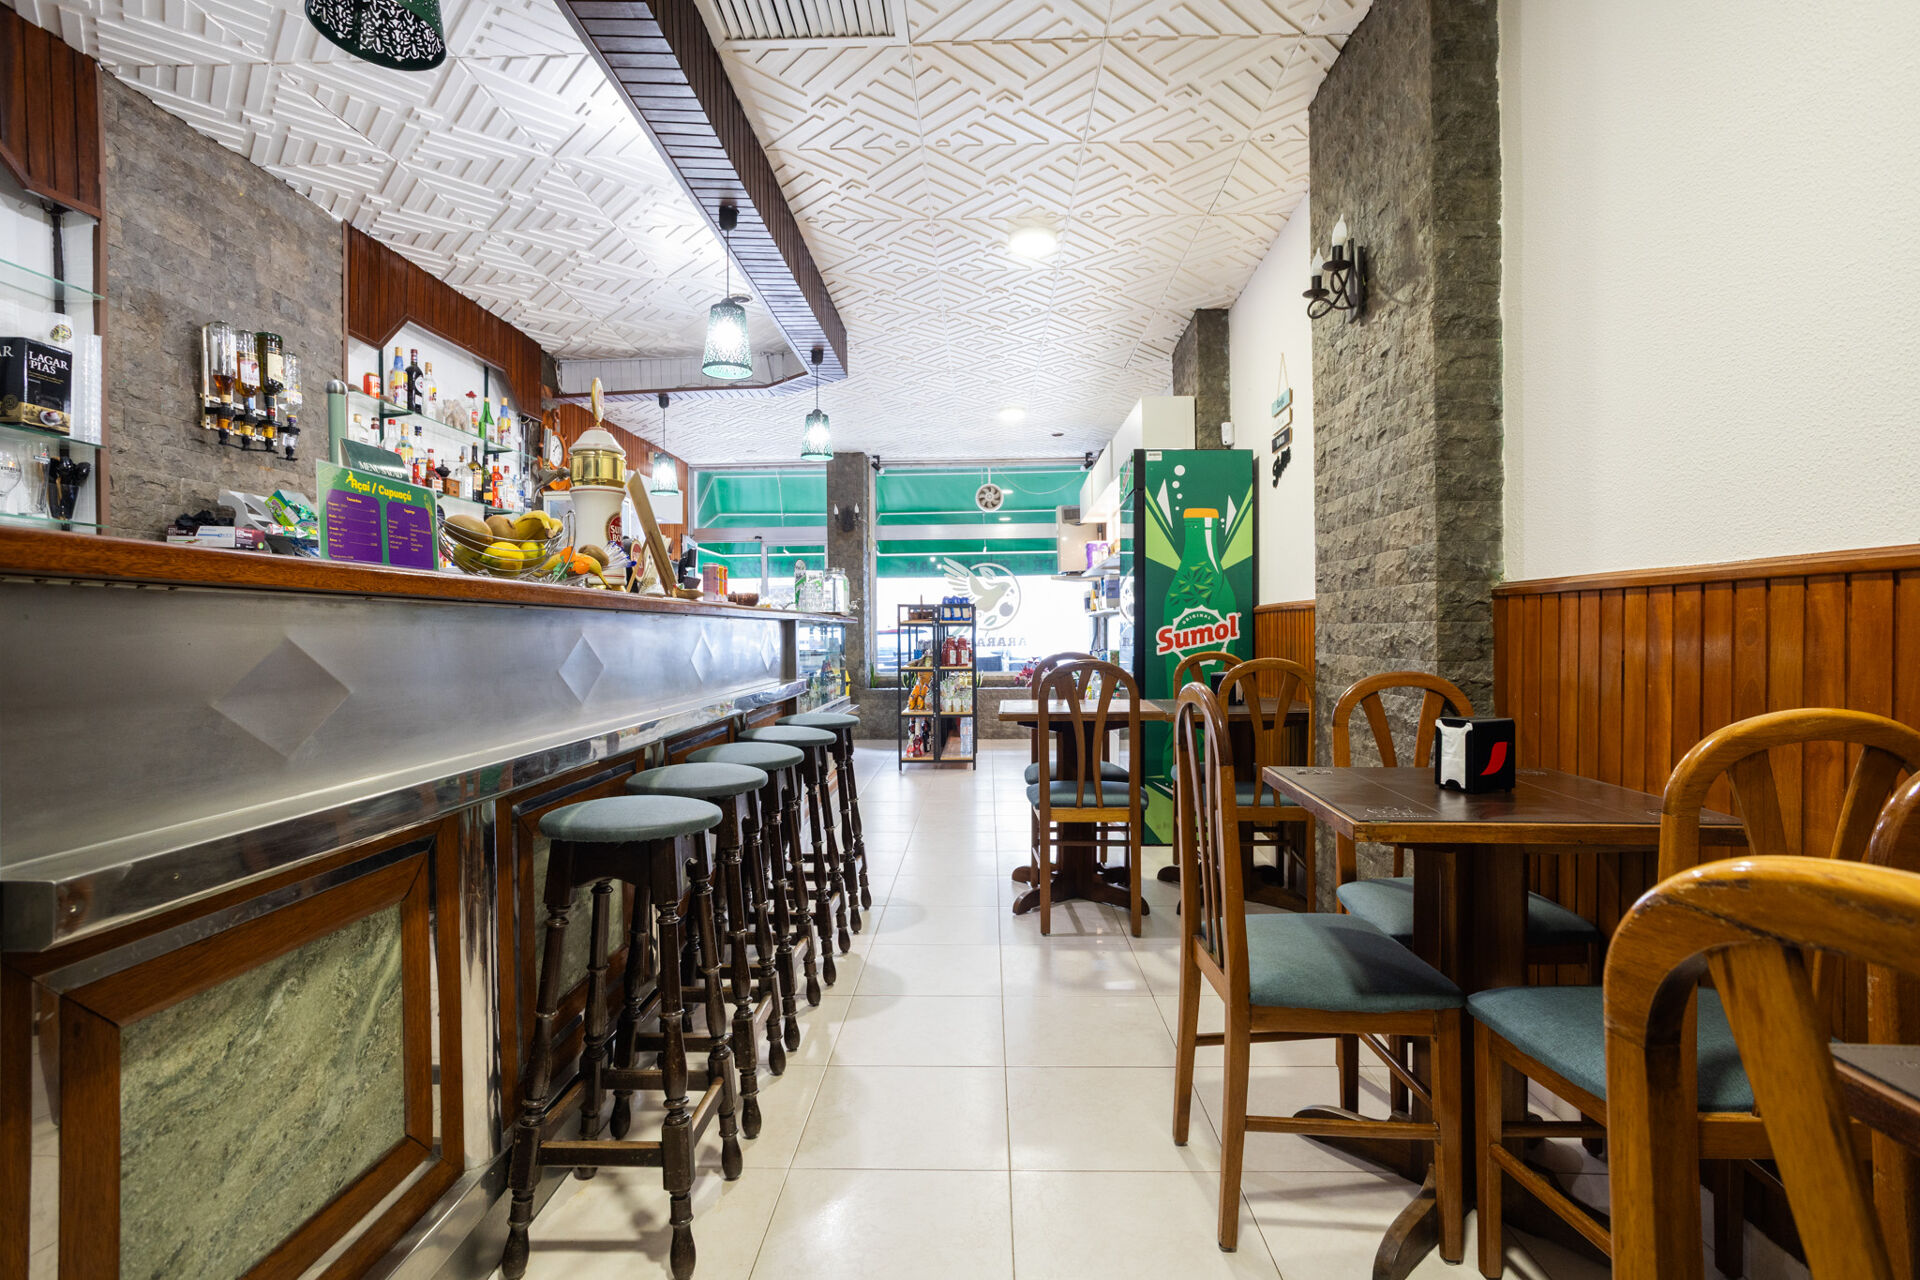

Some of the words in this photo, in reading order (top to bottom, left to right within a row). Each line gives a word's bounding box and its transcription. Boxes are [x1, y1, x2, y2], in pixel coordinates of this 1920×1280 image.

[28, 350, 70, 371] LAGAR
[30, 360, 56, 375] PIAS
[1181, 613, 1212, 625] ORIGINAL
[1157, 614, 1239, 653] Sumol
